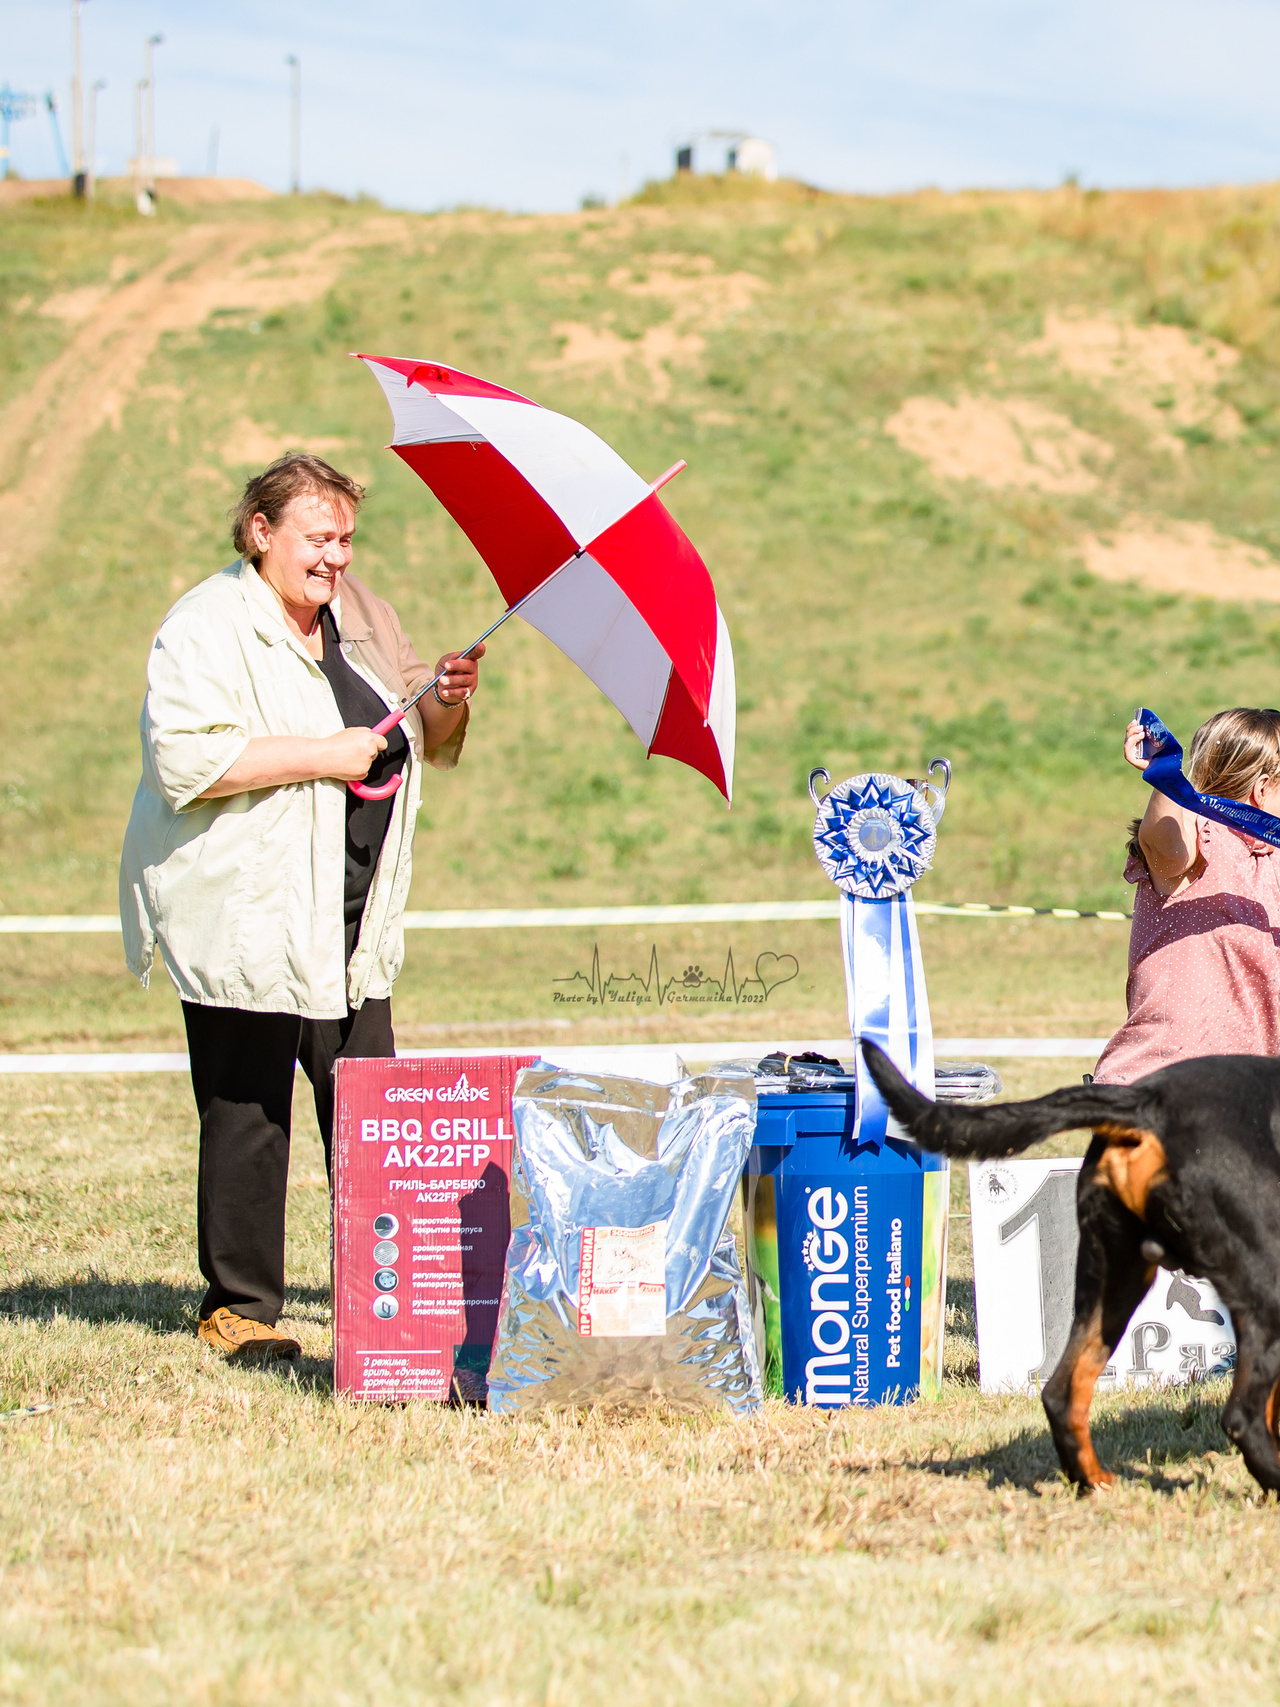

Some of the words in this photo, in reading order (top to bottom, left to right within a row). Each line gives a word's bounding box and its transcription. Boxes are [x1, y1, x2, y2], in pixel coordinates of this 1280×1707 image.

[384, 1087, 433, 1103] GREEN
[436, 1073, 490, 1103] GLADE
[361, 1118, 423, 1143] BBQ
[430, 1117, 514, 1142] GRILL
[382, 1144, 491, 1168] AK22FP
[388, 1179, 486, 1190] ГРИЛЬ-БАРБЕКЮ
[416, 1192, 459, 1203] AK22FP
[451, 1226, 483, 1234] корпуса
[886, 1218, 902, 1284] italiano
[851, 1185, 873, 1329] Superpremium
[412, 1272, 462, 1280] регулировка
[412, 1281, 464, 1289] температуры
[579, 1229, 595, 1335] ПРОФЕССИОНАЛ
[412, 1299, 435, 1307] ручки
[446, 1298, 499, 1307] жаропрочной
[412, 1307, 460, 1316] пластмассы
[886, 1288, 902, 1333] food
[886, 1335, 901, 1368] Pet
[363, 1357, 370, 1366] 3
[371, 1358, 410, 1368] режима:
[362, 1368, 392, 1377] гриль,
[395, 1367, 444, 1377] «духовка»,
[852, 1334, 869, 1404] Natural
[362, 1378, 400, 1388] горячее
[401, 1378, 445, 1387] копчение
